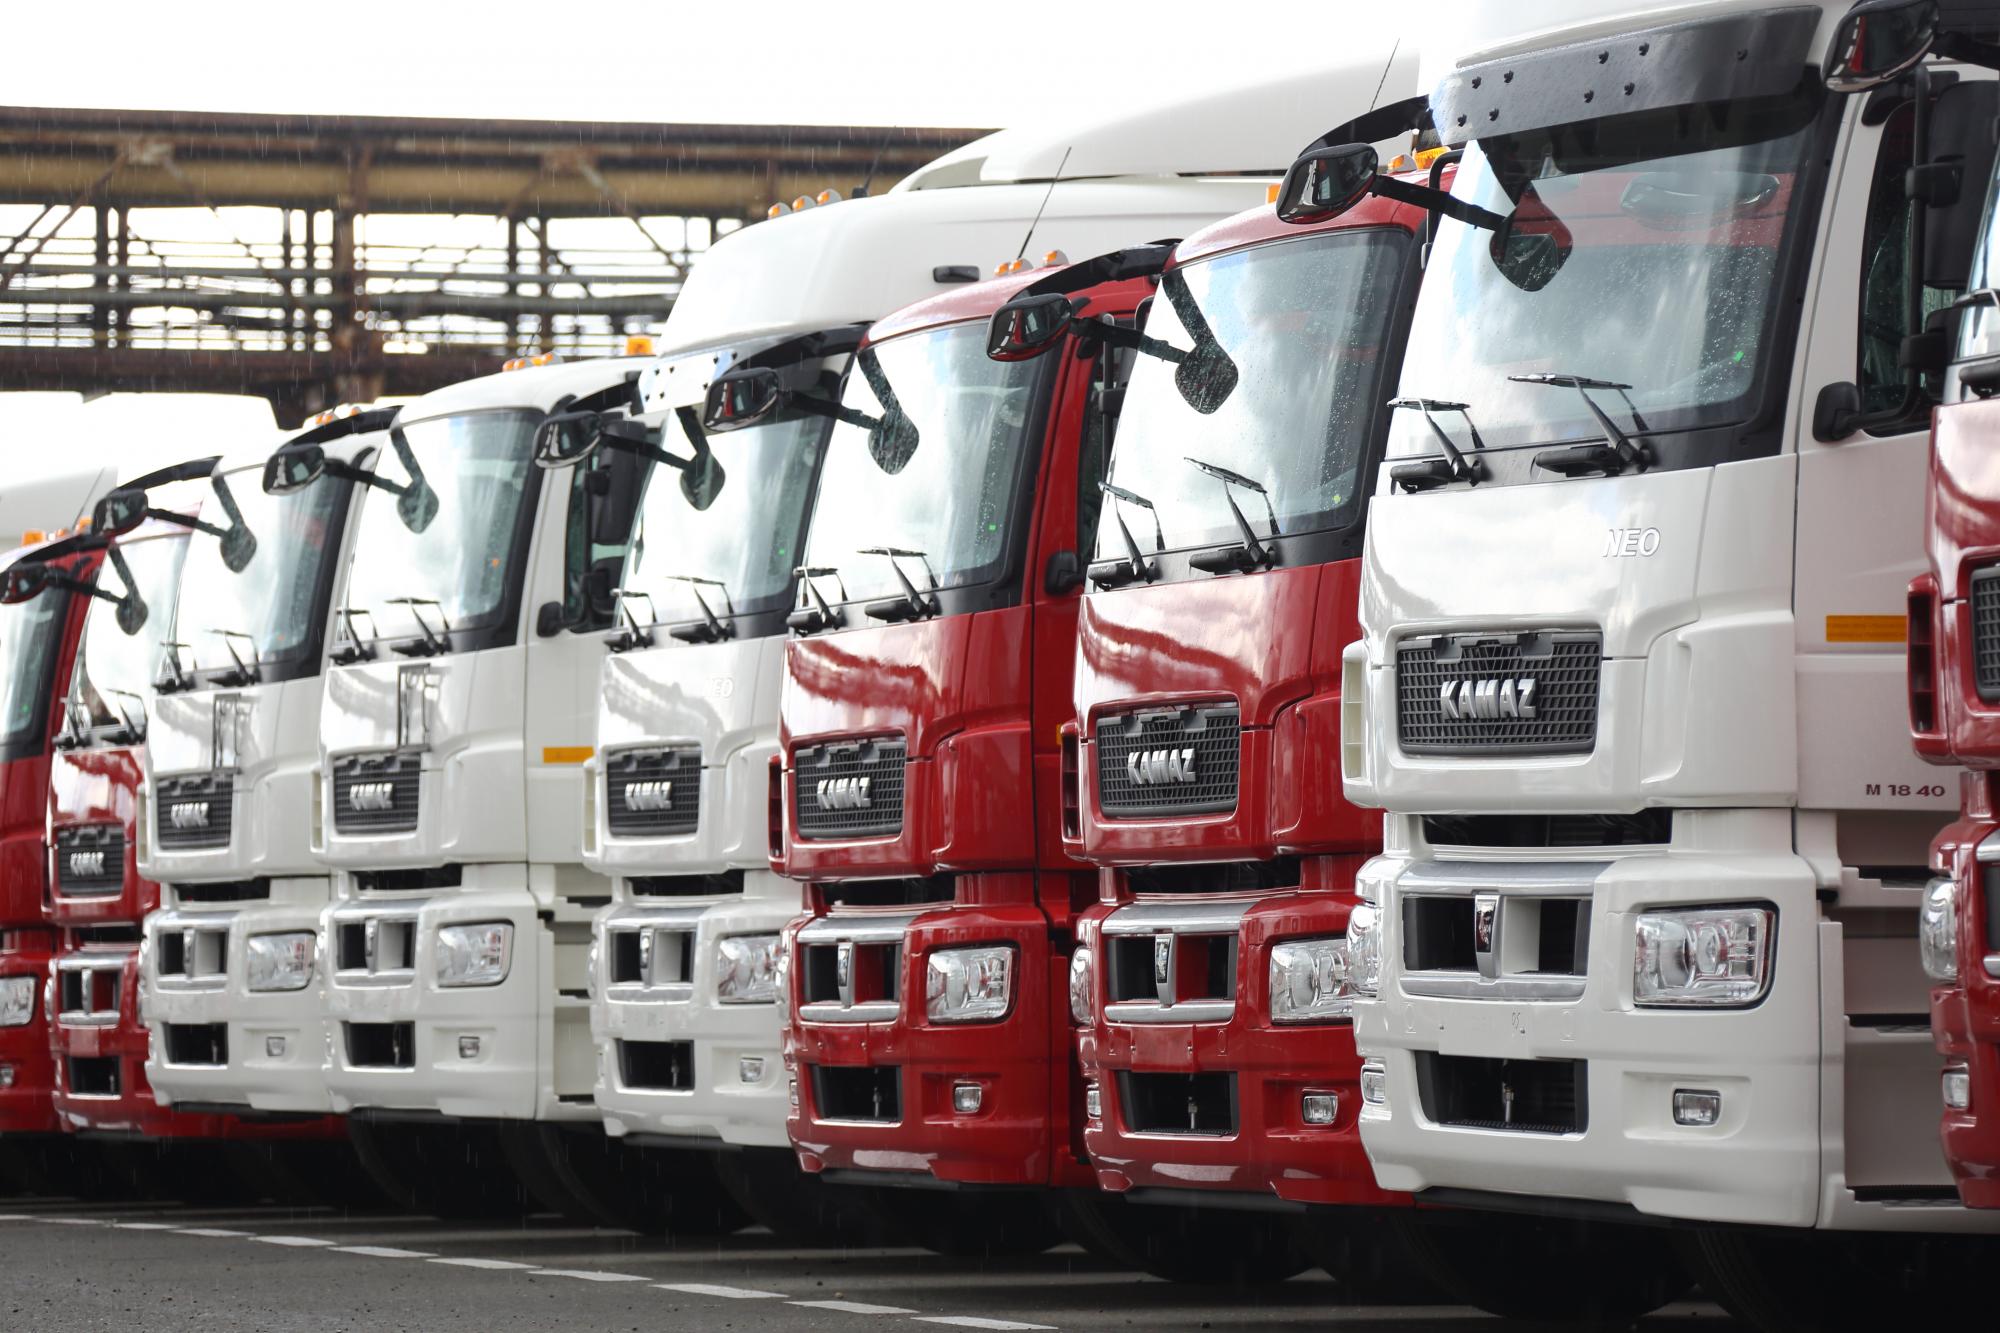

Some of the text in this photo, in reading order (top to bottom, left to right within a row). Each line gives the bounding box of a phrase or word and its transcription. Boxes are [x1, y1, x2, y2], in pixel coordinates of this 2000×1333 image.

[1601, 527, 1661, 557] NEO
[1441, 679, 1537, 719] KAMAZ
[1127, 748, 1196, 785] KAMAZ
[816, 777, 871, 809] KAMAZ
[1866, 784, 1946, 797] M 18 40
